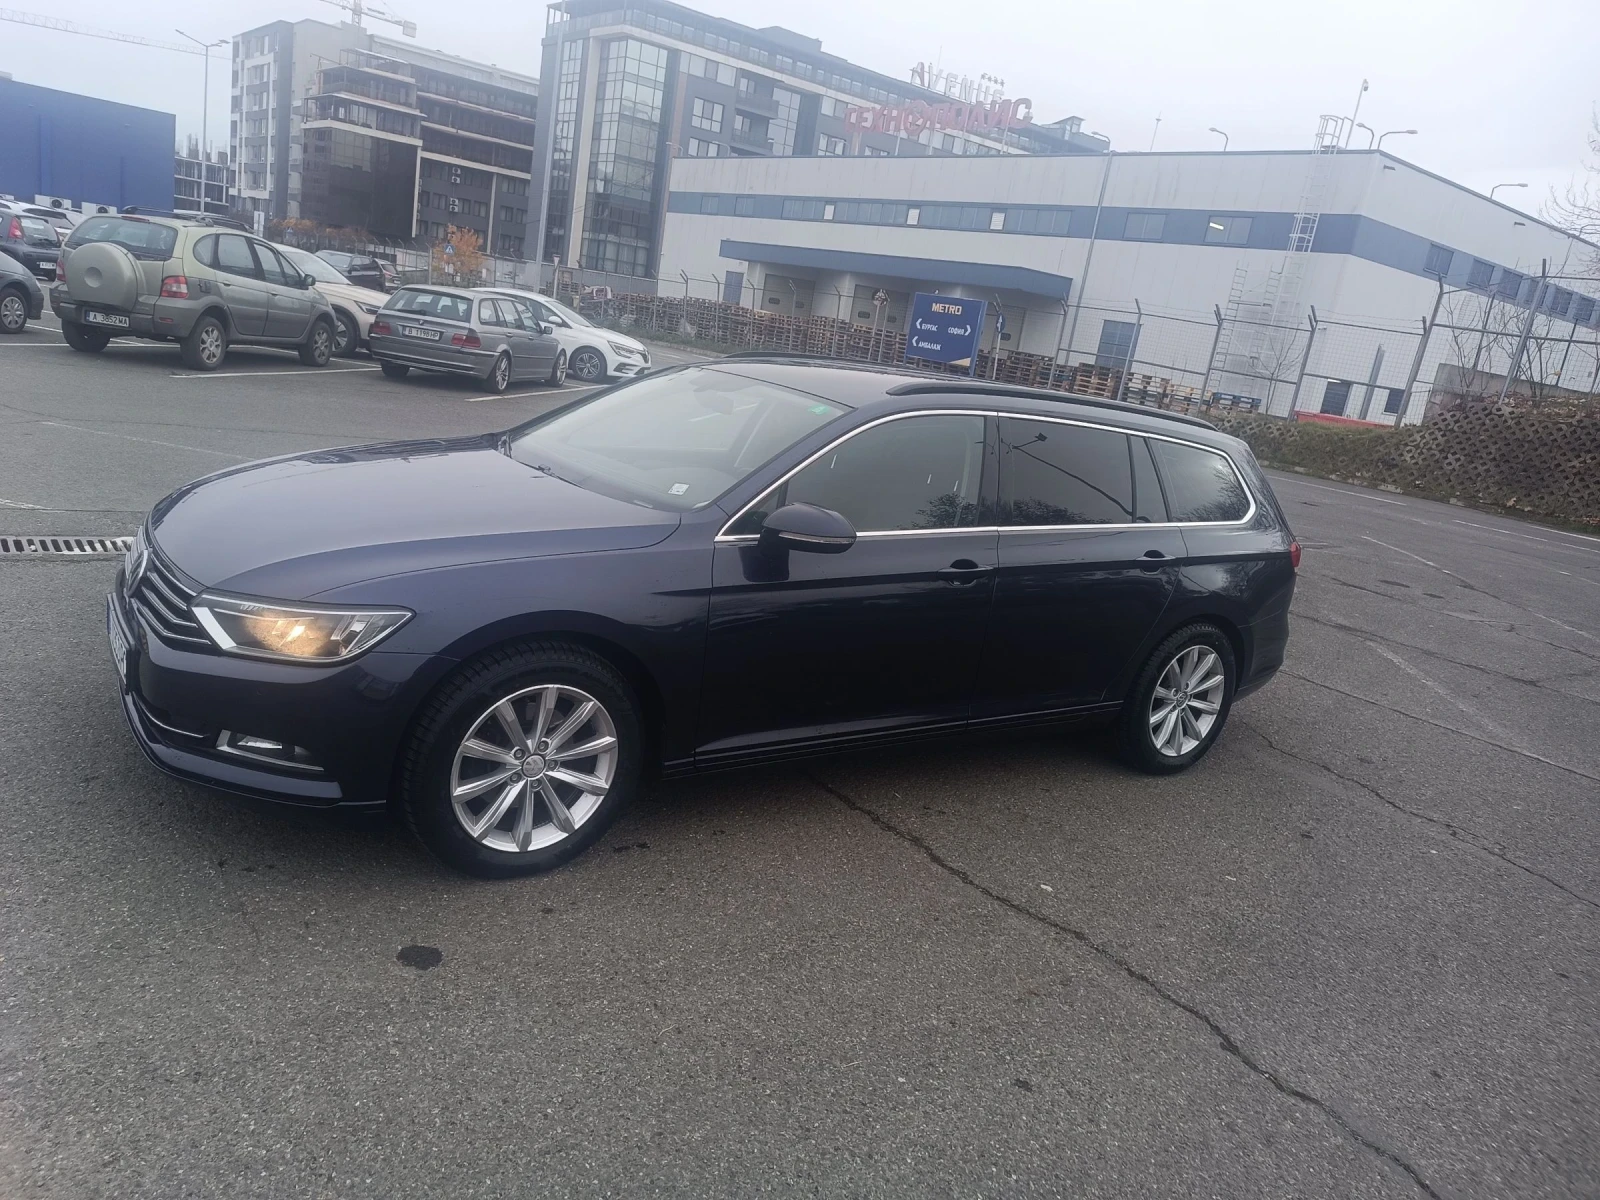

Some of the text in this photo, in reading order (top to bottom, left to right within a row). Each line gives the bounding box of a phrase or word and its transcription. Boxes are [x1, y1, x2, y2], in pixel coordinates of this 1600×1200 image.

[932, 303, 962, 315] METRO
[948, 327, 964, 335] СОФИЯ
[918, 341, 941, 350] АМБАЛАЖ
